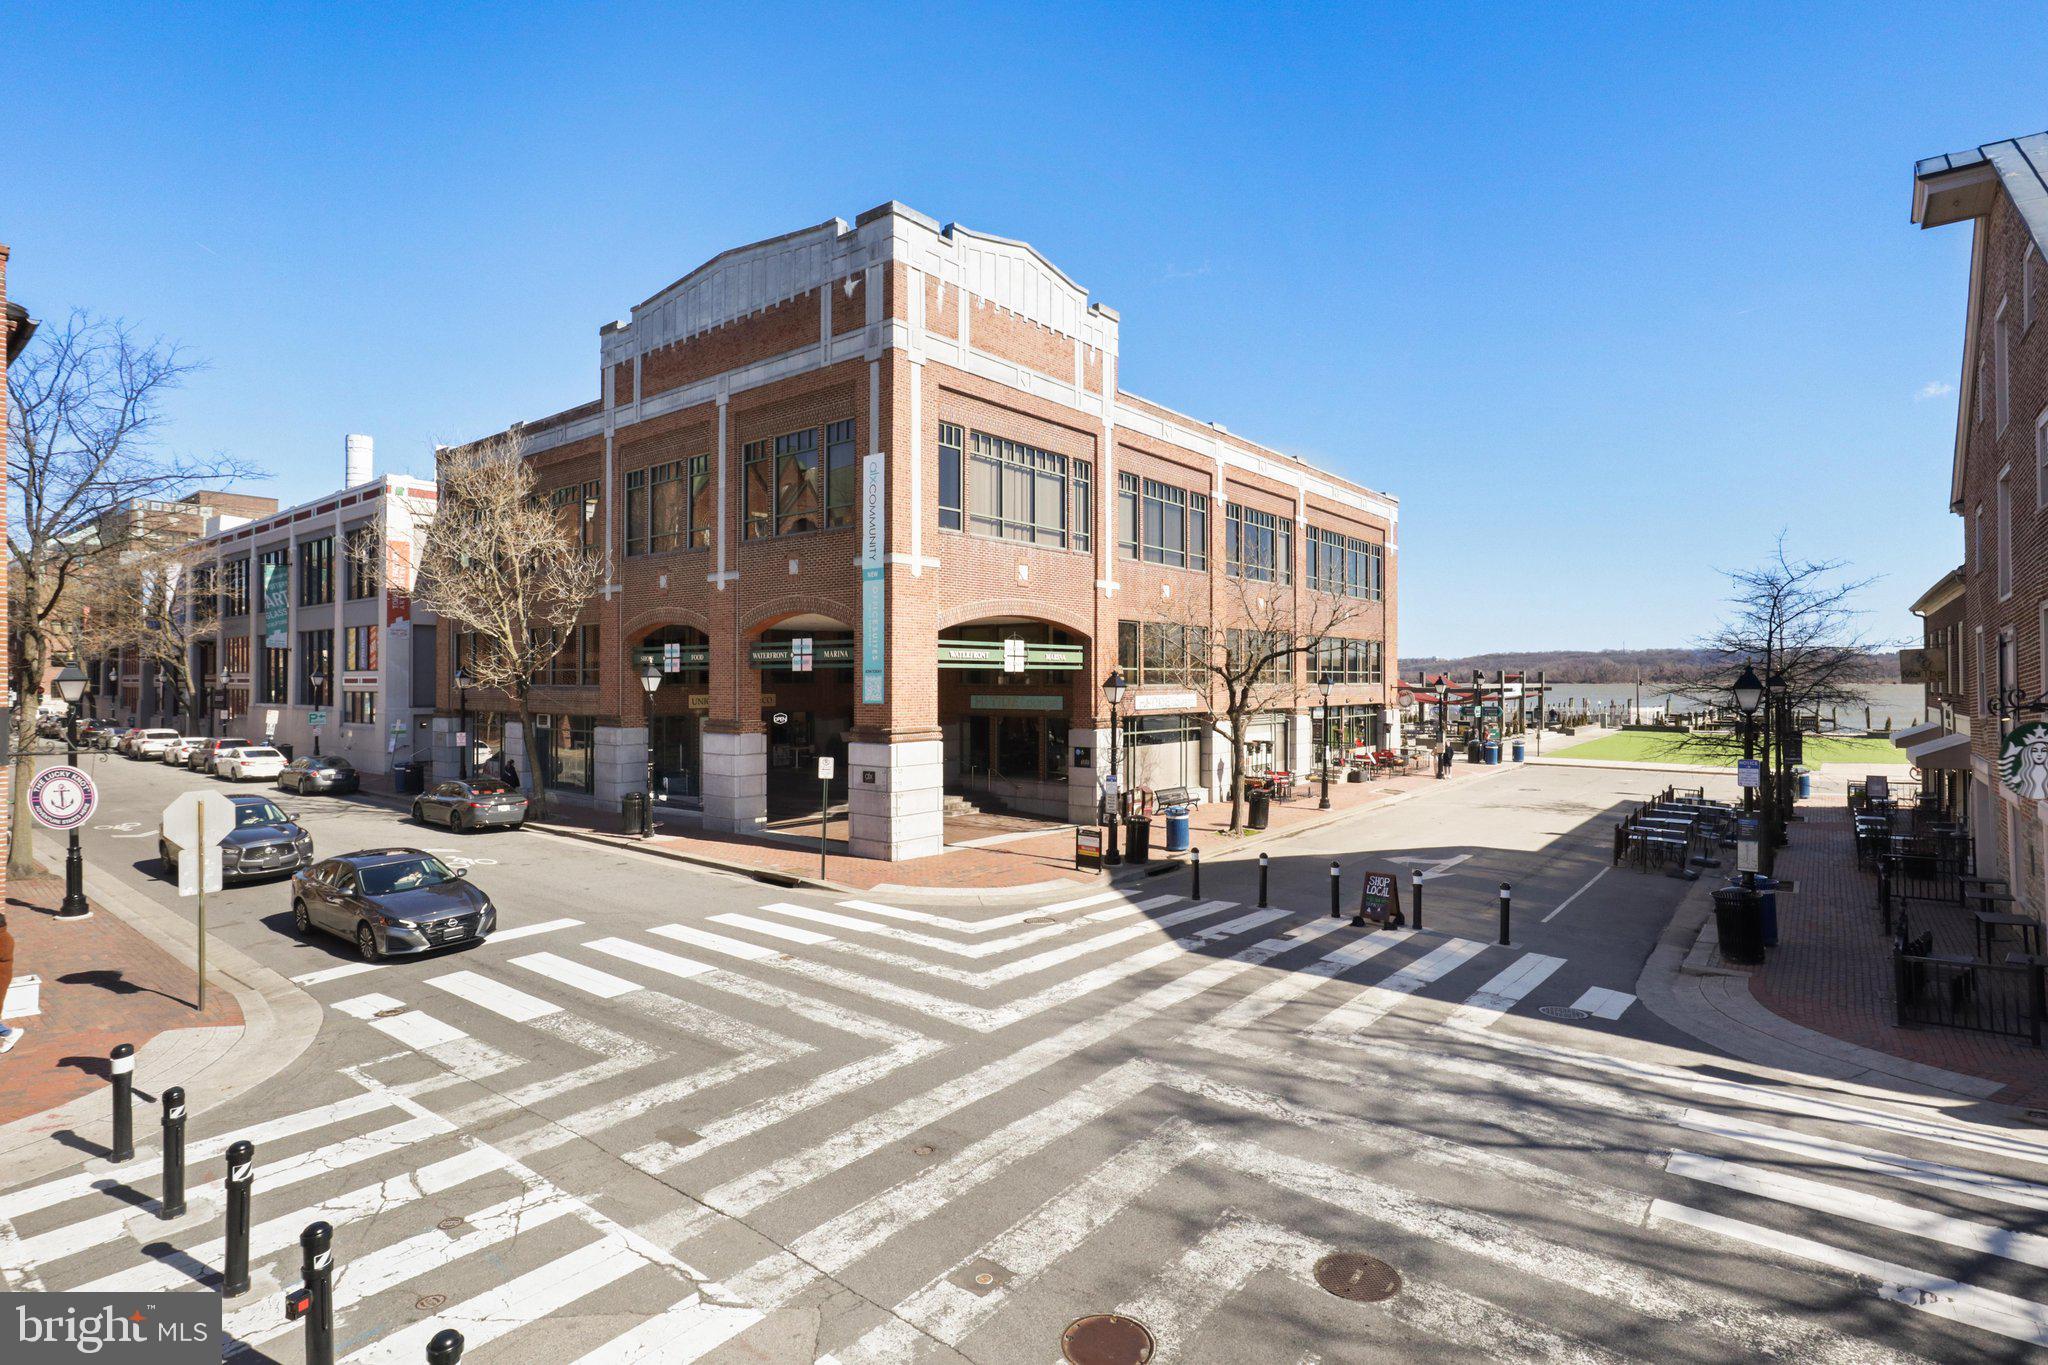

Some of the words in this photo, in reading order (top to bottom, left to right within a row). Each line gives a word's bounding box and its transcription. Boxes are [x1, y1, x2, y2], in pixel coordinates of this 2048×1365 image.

[265, 590, 290, 609] ART
[265, 609, 288, 620] GLASS
[752, 651, 788, 660] WATERFRONT
[823, 650, 849, 658] MARINA
[309, 713, 318, 723] P
[33, 778, 45, 792] THE
[44, 771, 71, 780] LUCKY
[35, 806, 61, 825] ADVENTURE
[62, 814, 82, 825] STARTS
[1369, 876, 1390, 887] SHOP
[1367, 885, 1390, 897] LOCAL
